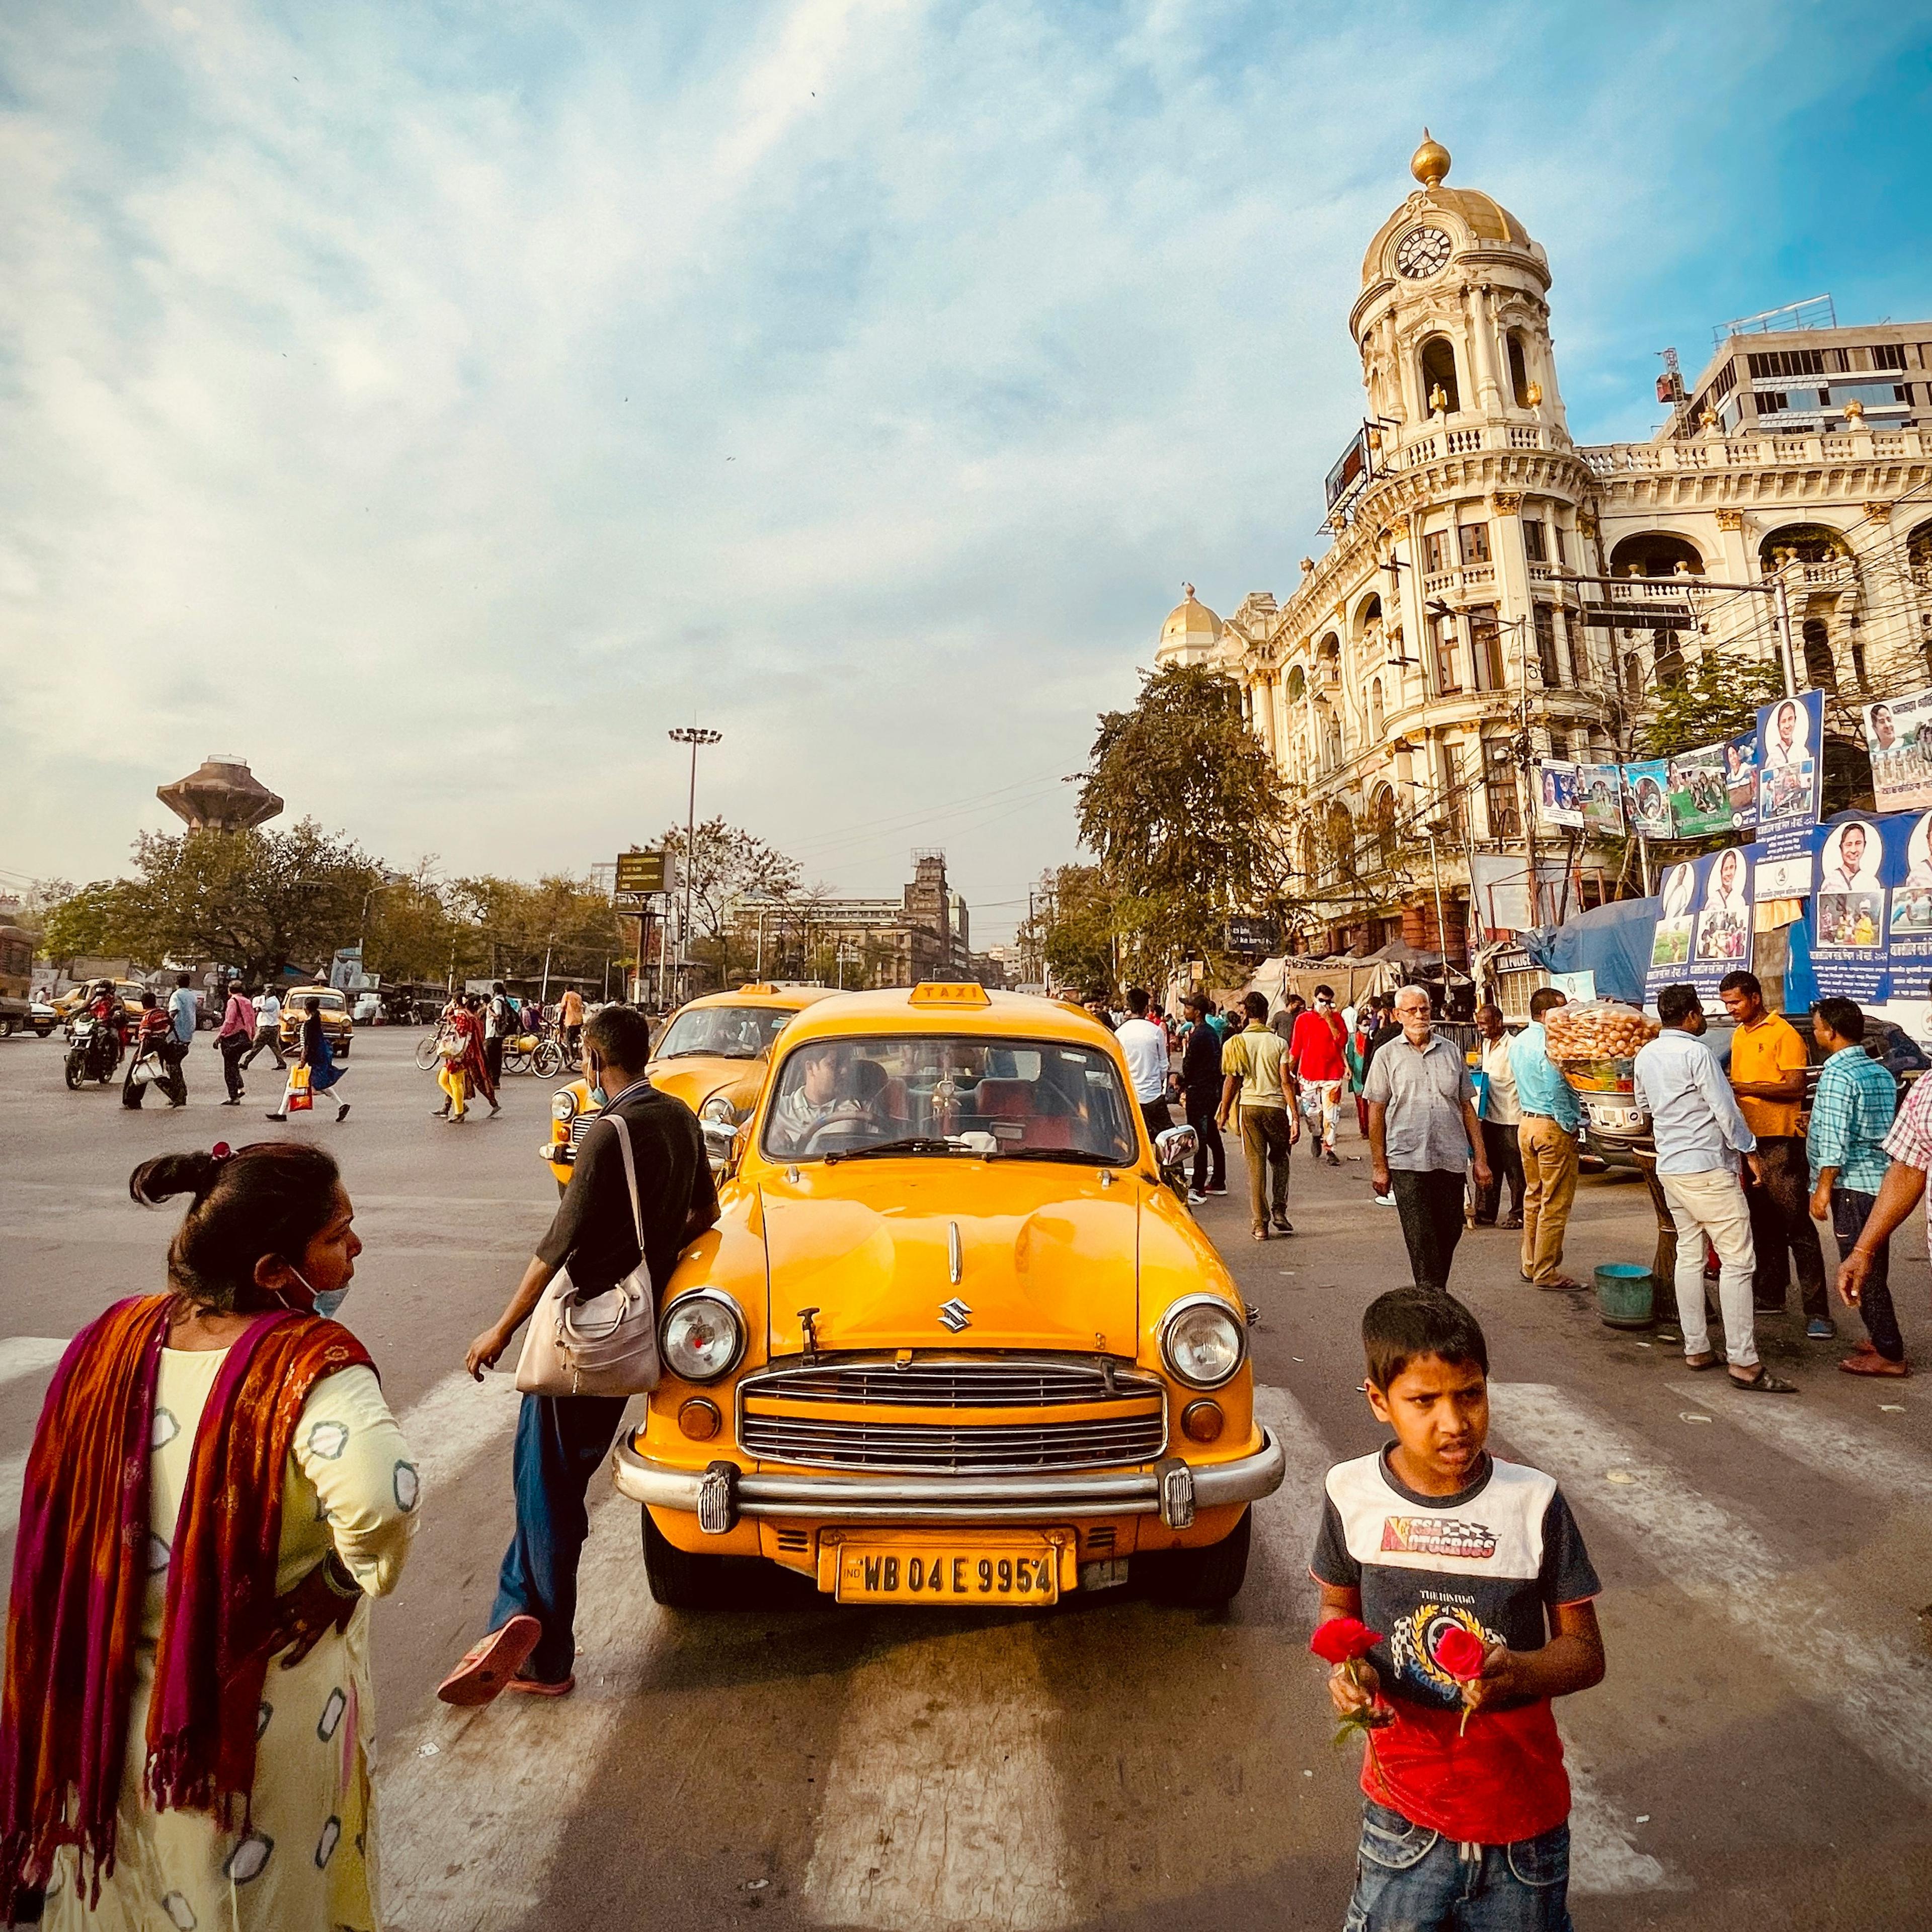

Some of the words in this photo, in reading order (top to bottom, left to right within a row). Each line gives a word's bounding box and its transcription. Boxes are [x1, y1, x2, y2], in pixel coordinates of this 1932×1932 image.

[924, 987, 977, 998] TAXI
[844, 1569, 860, 1578] IND
[863, 1555, 900, 1592] WB
[908, 1557, 943, 1592] 04
[952, 1557, 970, 1593] E
[978, 1558, 1051, 1593] 9954
[1441, 1604, 1450, 1615] of
